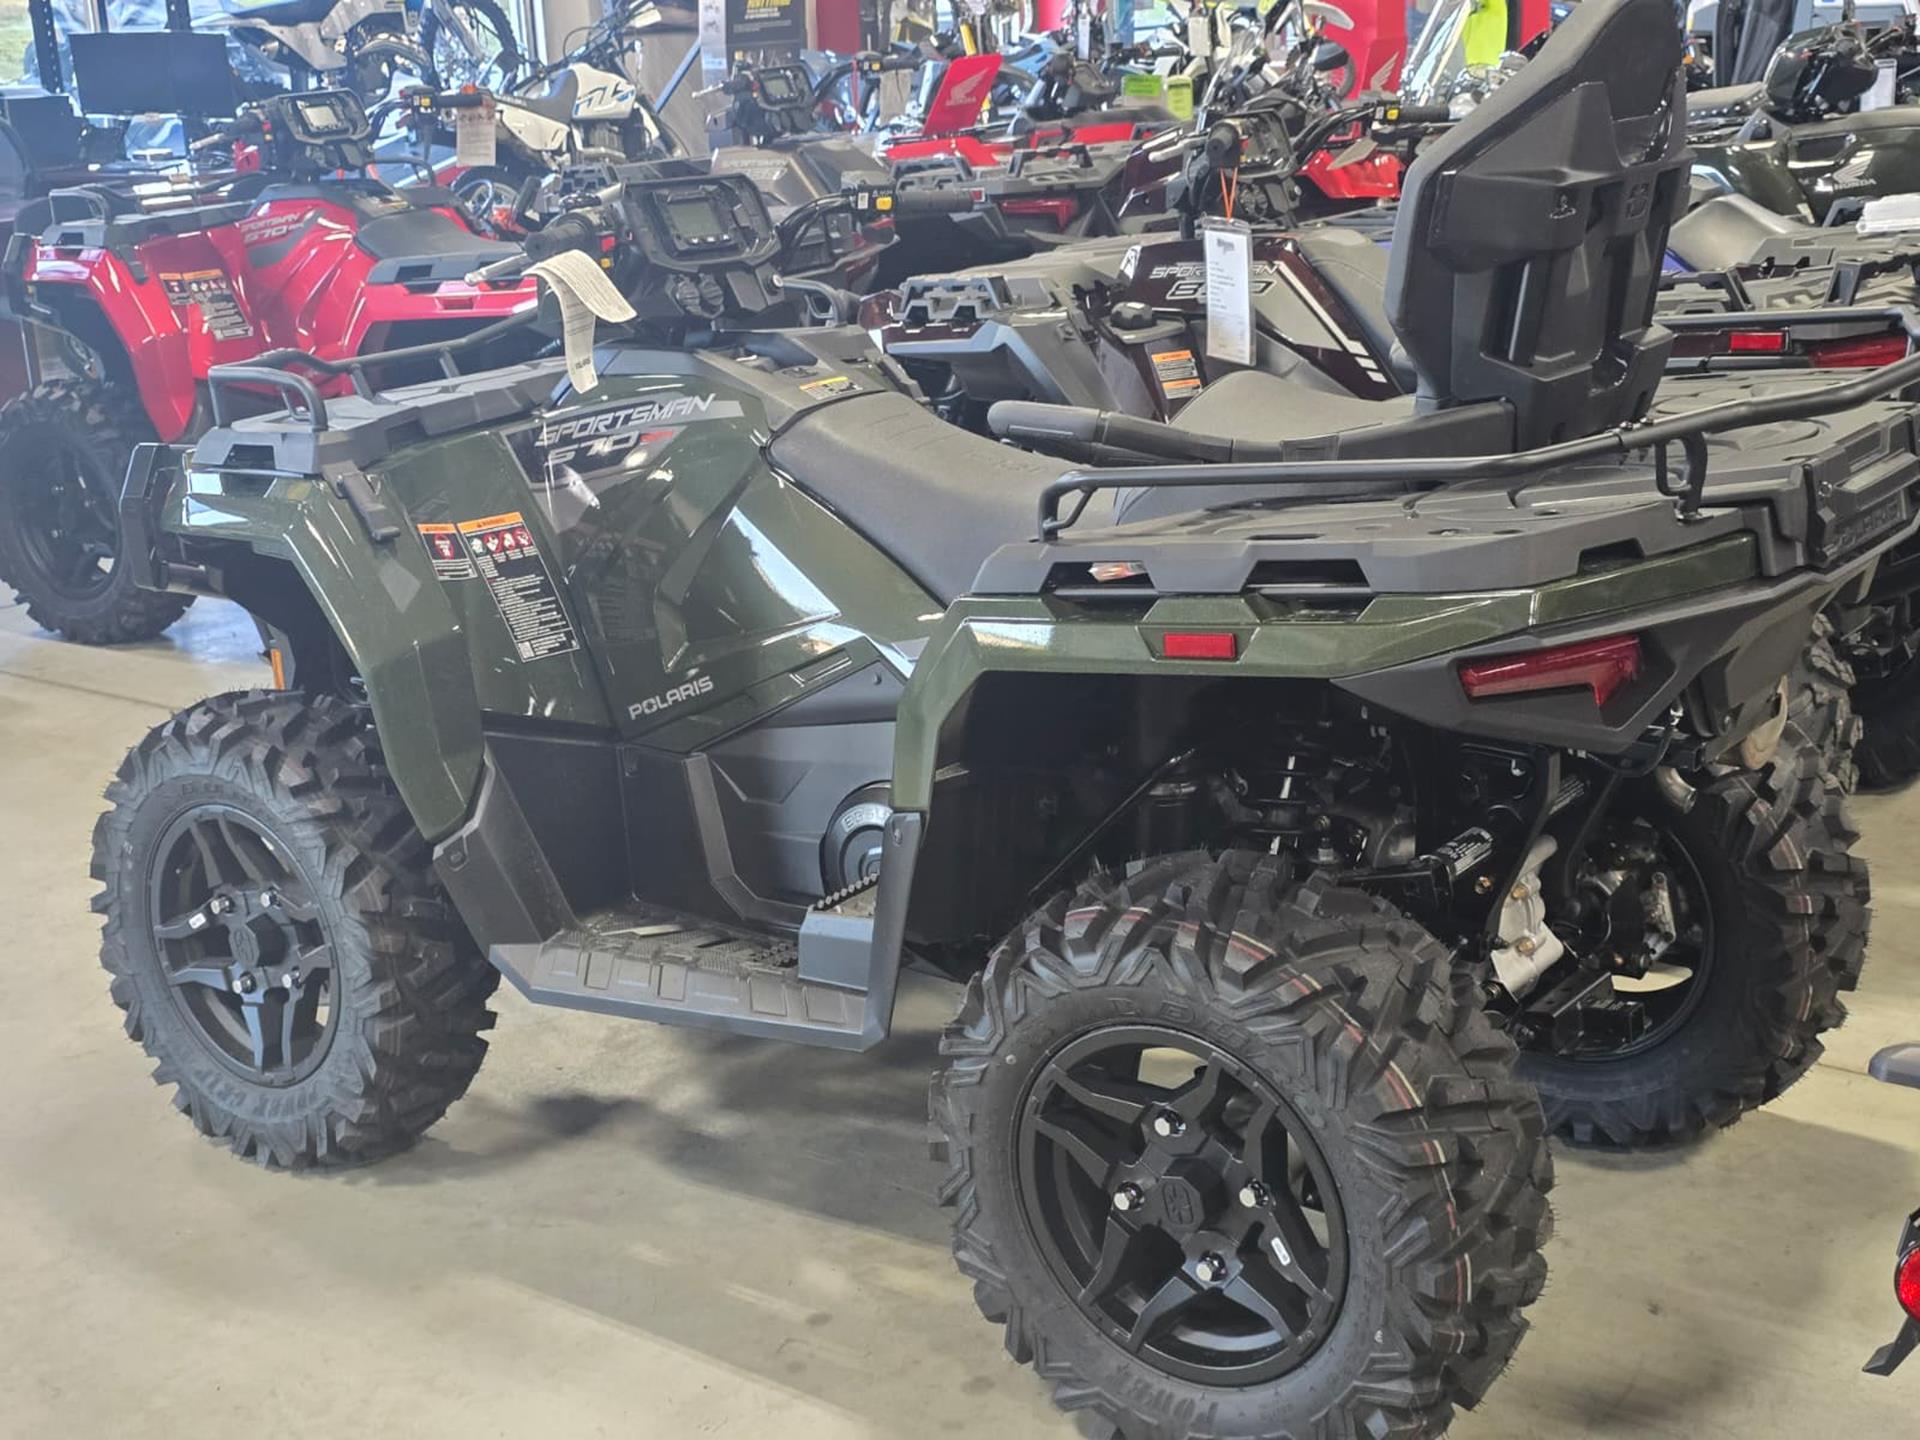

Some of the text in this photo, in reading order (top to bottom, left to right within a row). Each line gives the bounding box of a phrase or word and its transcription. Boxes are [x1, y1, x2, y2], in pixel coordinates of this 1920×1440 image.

[534, 393, 716, 447] SPORTSMAN
[544, 430, 641, 467] 570
[628, 675, 714, 720] POLARIS
